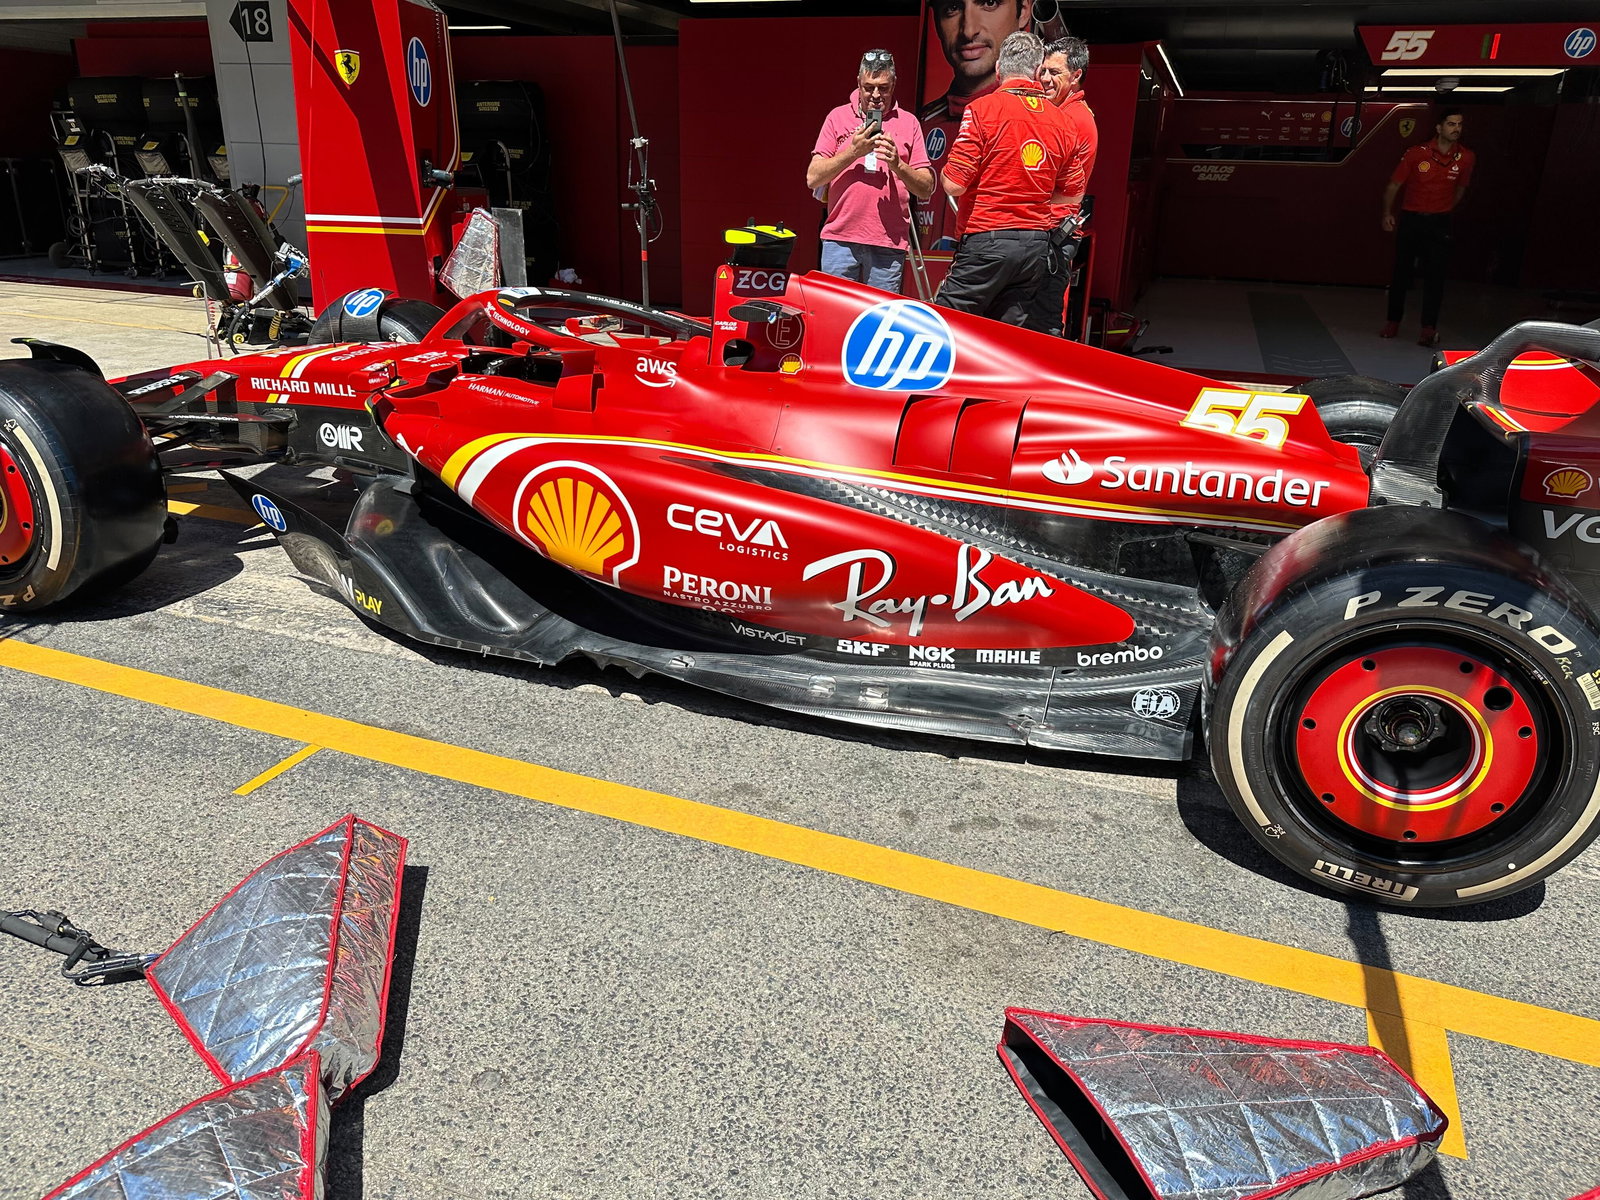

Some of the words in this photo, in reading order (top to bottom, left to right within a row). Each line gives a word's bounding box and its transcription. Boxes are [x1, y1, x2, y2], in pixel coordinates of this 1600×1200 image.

[241, 8, 270, 36] 18
[1381, 30, 1435, 60] 55
[1566, 29, 1592, 58] hp
[412, 38, 428, 107] hp
[927, 128, 944, 160] hp
[1192, 165, 1235, 174] CARLOS
[1197, 173, 1231, 181] SAINZ
[345, 289, 382, 317] hp
[492, 311, 530, 336] TECHNOLOGY
[854, 301, 944, 390] hp
[636, 356, 677, 378] aws
[251, 377, 310, 394] RICHARD
[315, 381, 357, 398] MILLE
[468, 382, 503, 397] HARMAN
[505, 391, 540, 406] AUTOMOTIVE
[1178, 386, 1310, 450] 55
[1100, 456, 1330, 508] Santander
[255, 494, 284, 531] hp
[719, 542, 789, 561] LOGISTICS
[663, 565, 772, 605] PERONI
[354, 588, 383, 615] PLAY
[663, 590, 710, 604] NASTRO
[714, 600, 772, 611] AZZURRO
[1343, 590, 1382, 620] P
[1397, 586, 1577, 654] ZERO
[730, 621, 806, 646] VISTAJET
[837, 639, 890, 657] SKF
[909, 645, 955, 663] NGK
[976, 649, 1041, 665] MAHLE
[1077, 645, 1163, 667] brembo
[909, 660, 931, 669] SPARK
[933, 661, 955, 670] PLUGS
[1135, 692, 1176, 714] FIA
[1310, 859, 1420, 901] PIRELLI
